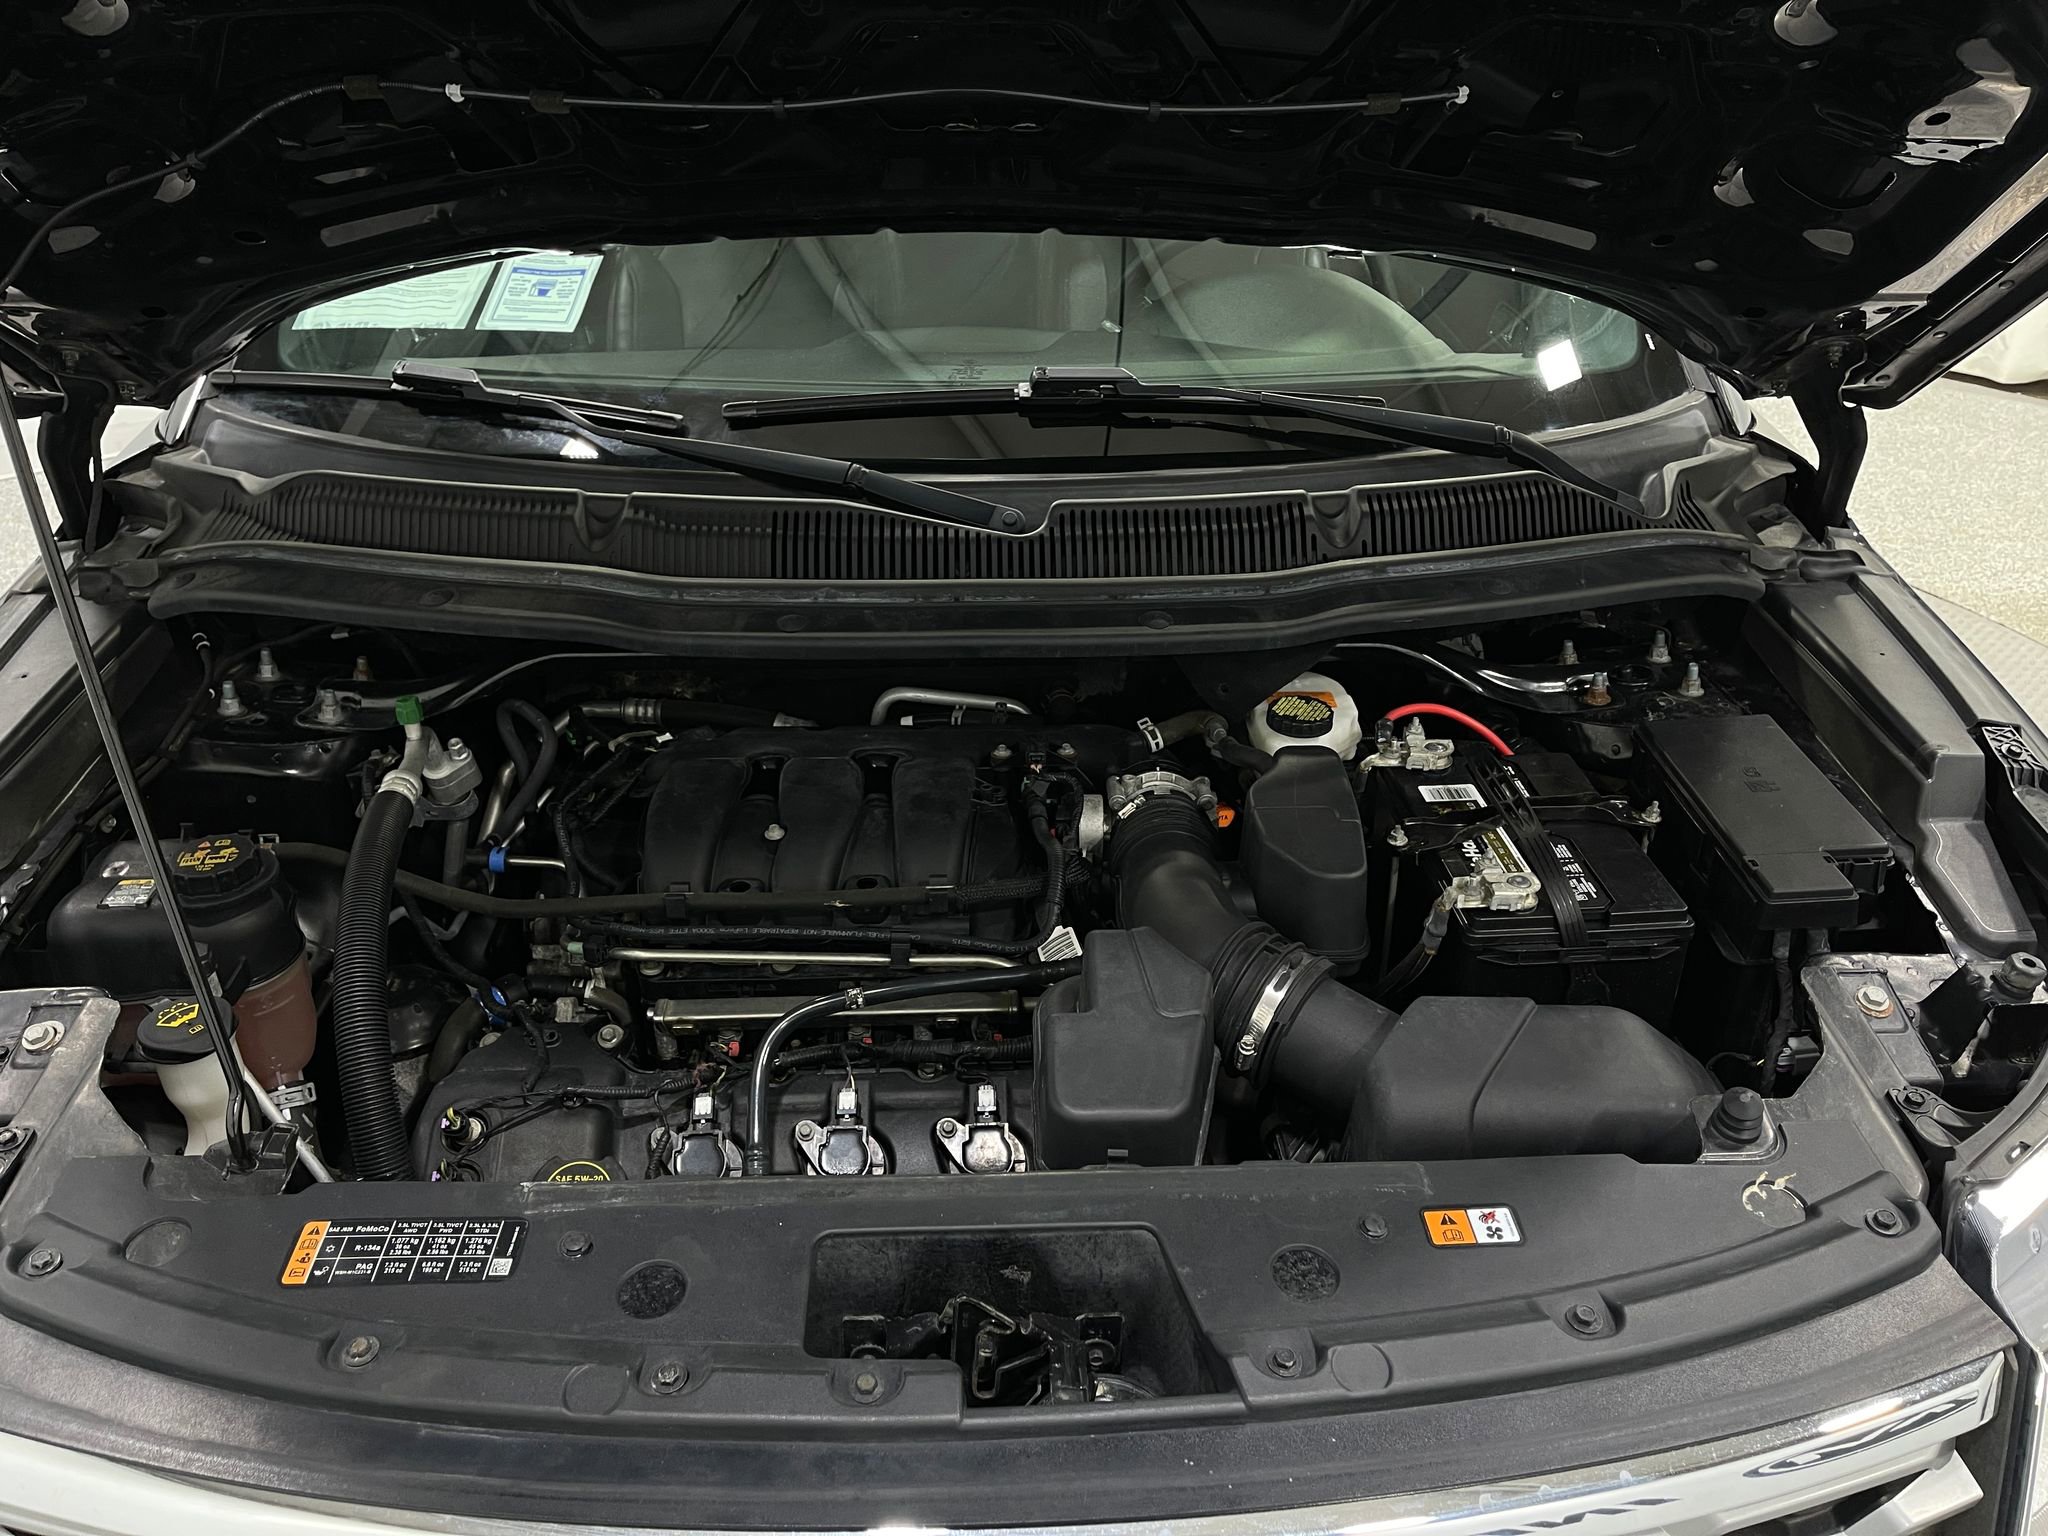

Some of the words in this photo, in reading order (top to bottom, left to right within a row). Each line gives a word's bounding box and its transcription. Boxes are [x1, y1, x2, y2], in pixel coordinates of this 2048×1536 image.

[410, 1237, 420, 1245] kg
[447, 1237, 456, 1245] kg
[484, 1237, 493, 1245] kg
